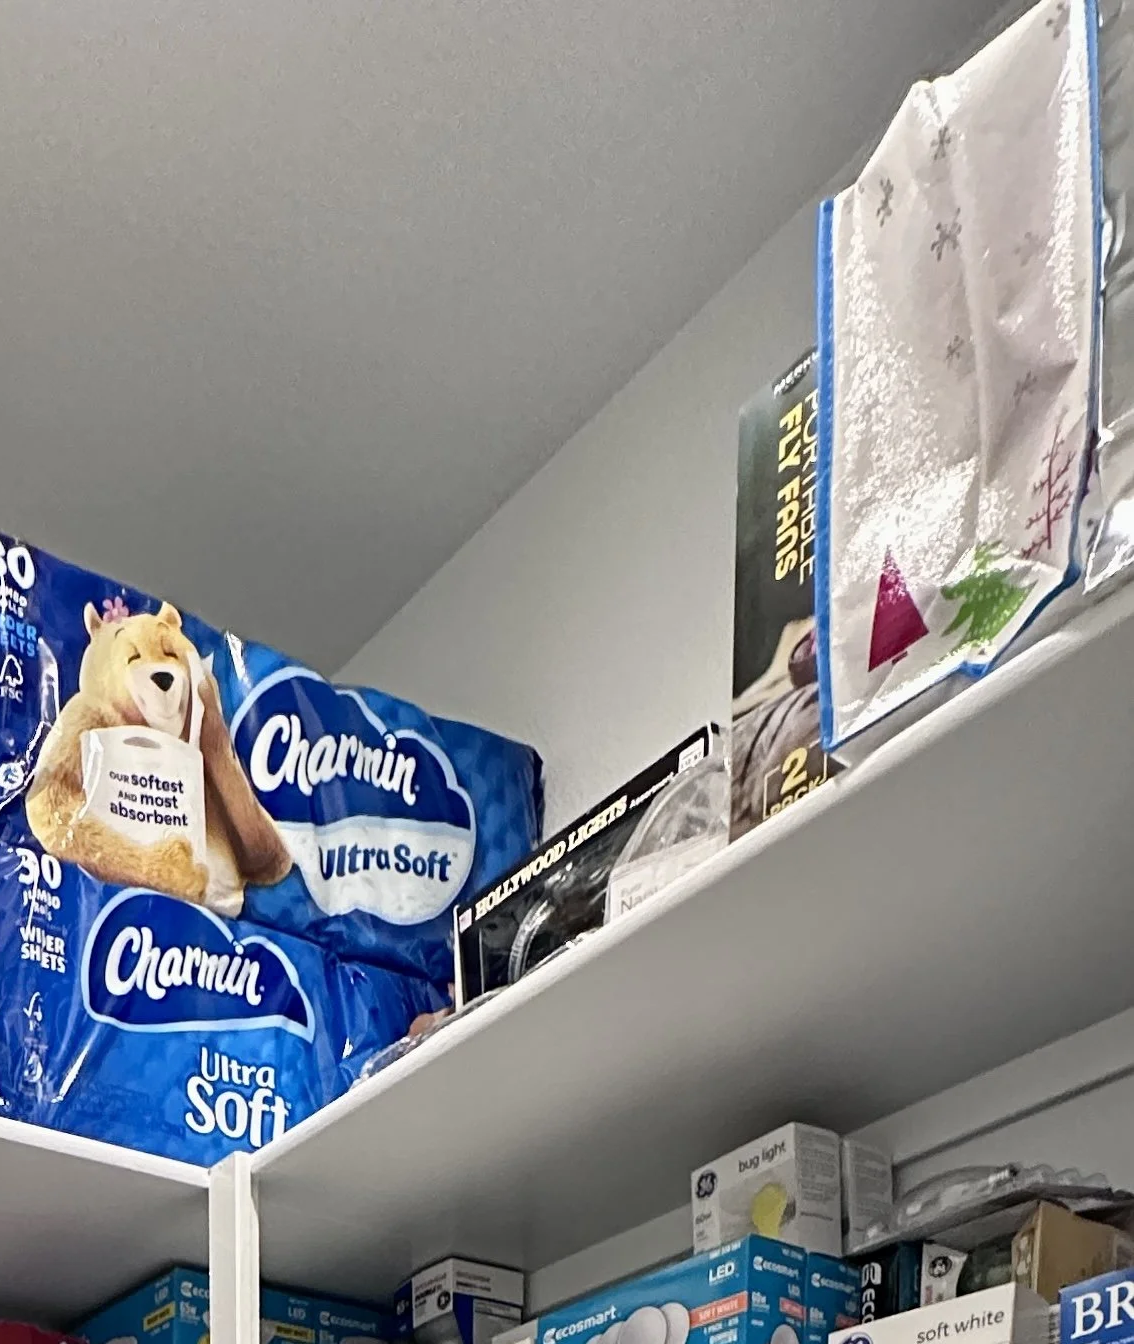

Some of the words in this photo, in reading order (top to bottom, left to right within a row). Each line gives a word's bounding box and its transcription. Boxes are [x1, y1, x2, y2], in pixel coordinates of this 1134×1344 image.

[777, 401, 804, 473] FLY
[774, 475, 801, 582] FANS
[0, 686, 23, 702] FSC
[250, 714, 417, 805] Charmin
[780, 747, 809, 796] 2
[131, 772, 184, 794] softest
[140, 792, 178, 809] most
[109, 800, 189, 828] absorbent
[318, 844, 391, 883] Ultra
[394, 844, 453, 883] Soft
[473, 836, 567, 921] HOLLYWOOD
[566, 795, 628, 854] LIGHTS
[105, 926, 263, 1005] Charmin
[200, 1049, 277, 1091] Ultra
[185, 1080, 291, 1147] Soft
[737, 1154, 761, 1174] bug
[761, 1141, 787, 1162] light
[708, 1261, 736, 1285] LED
[555, 1304, 617, 1341] ecosmart
[916, 1321, 950, 1344] soft
[953, 1308, 1006, 1335] white
[1070, 1281, 1134, 1340] BR
